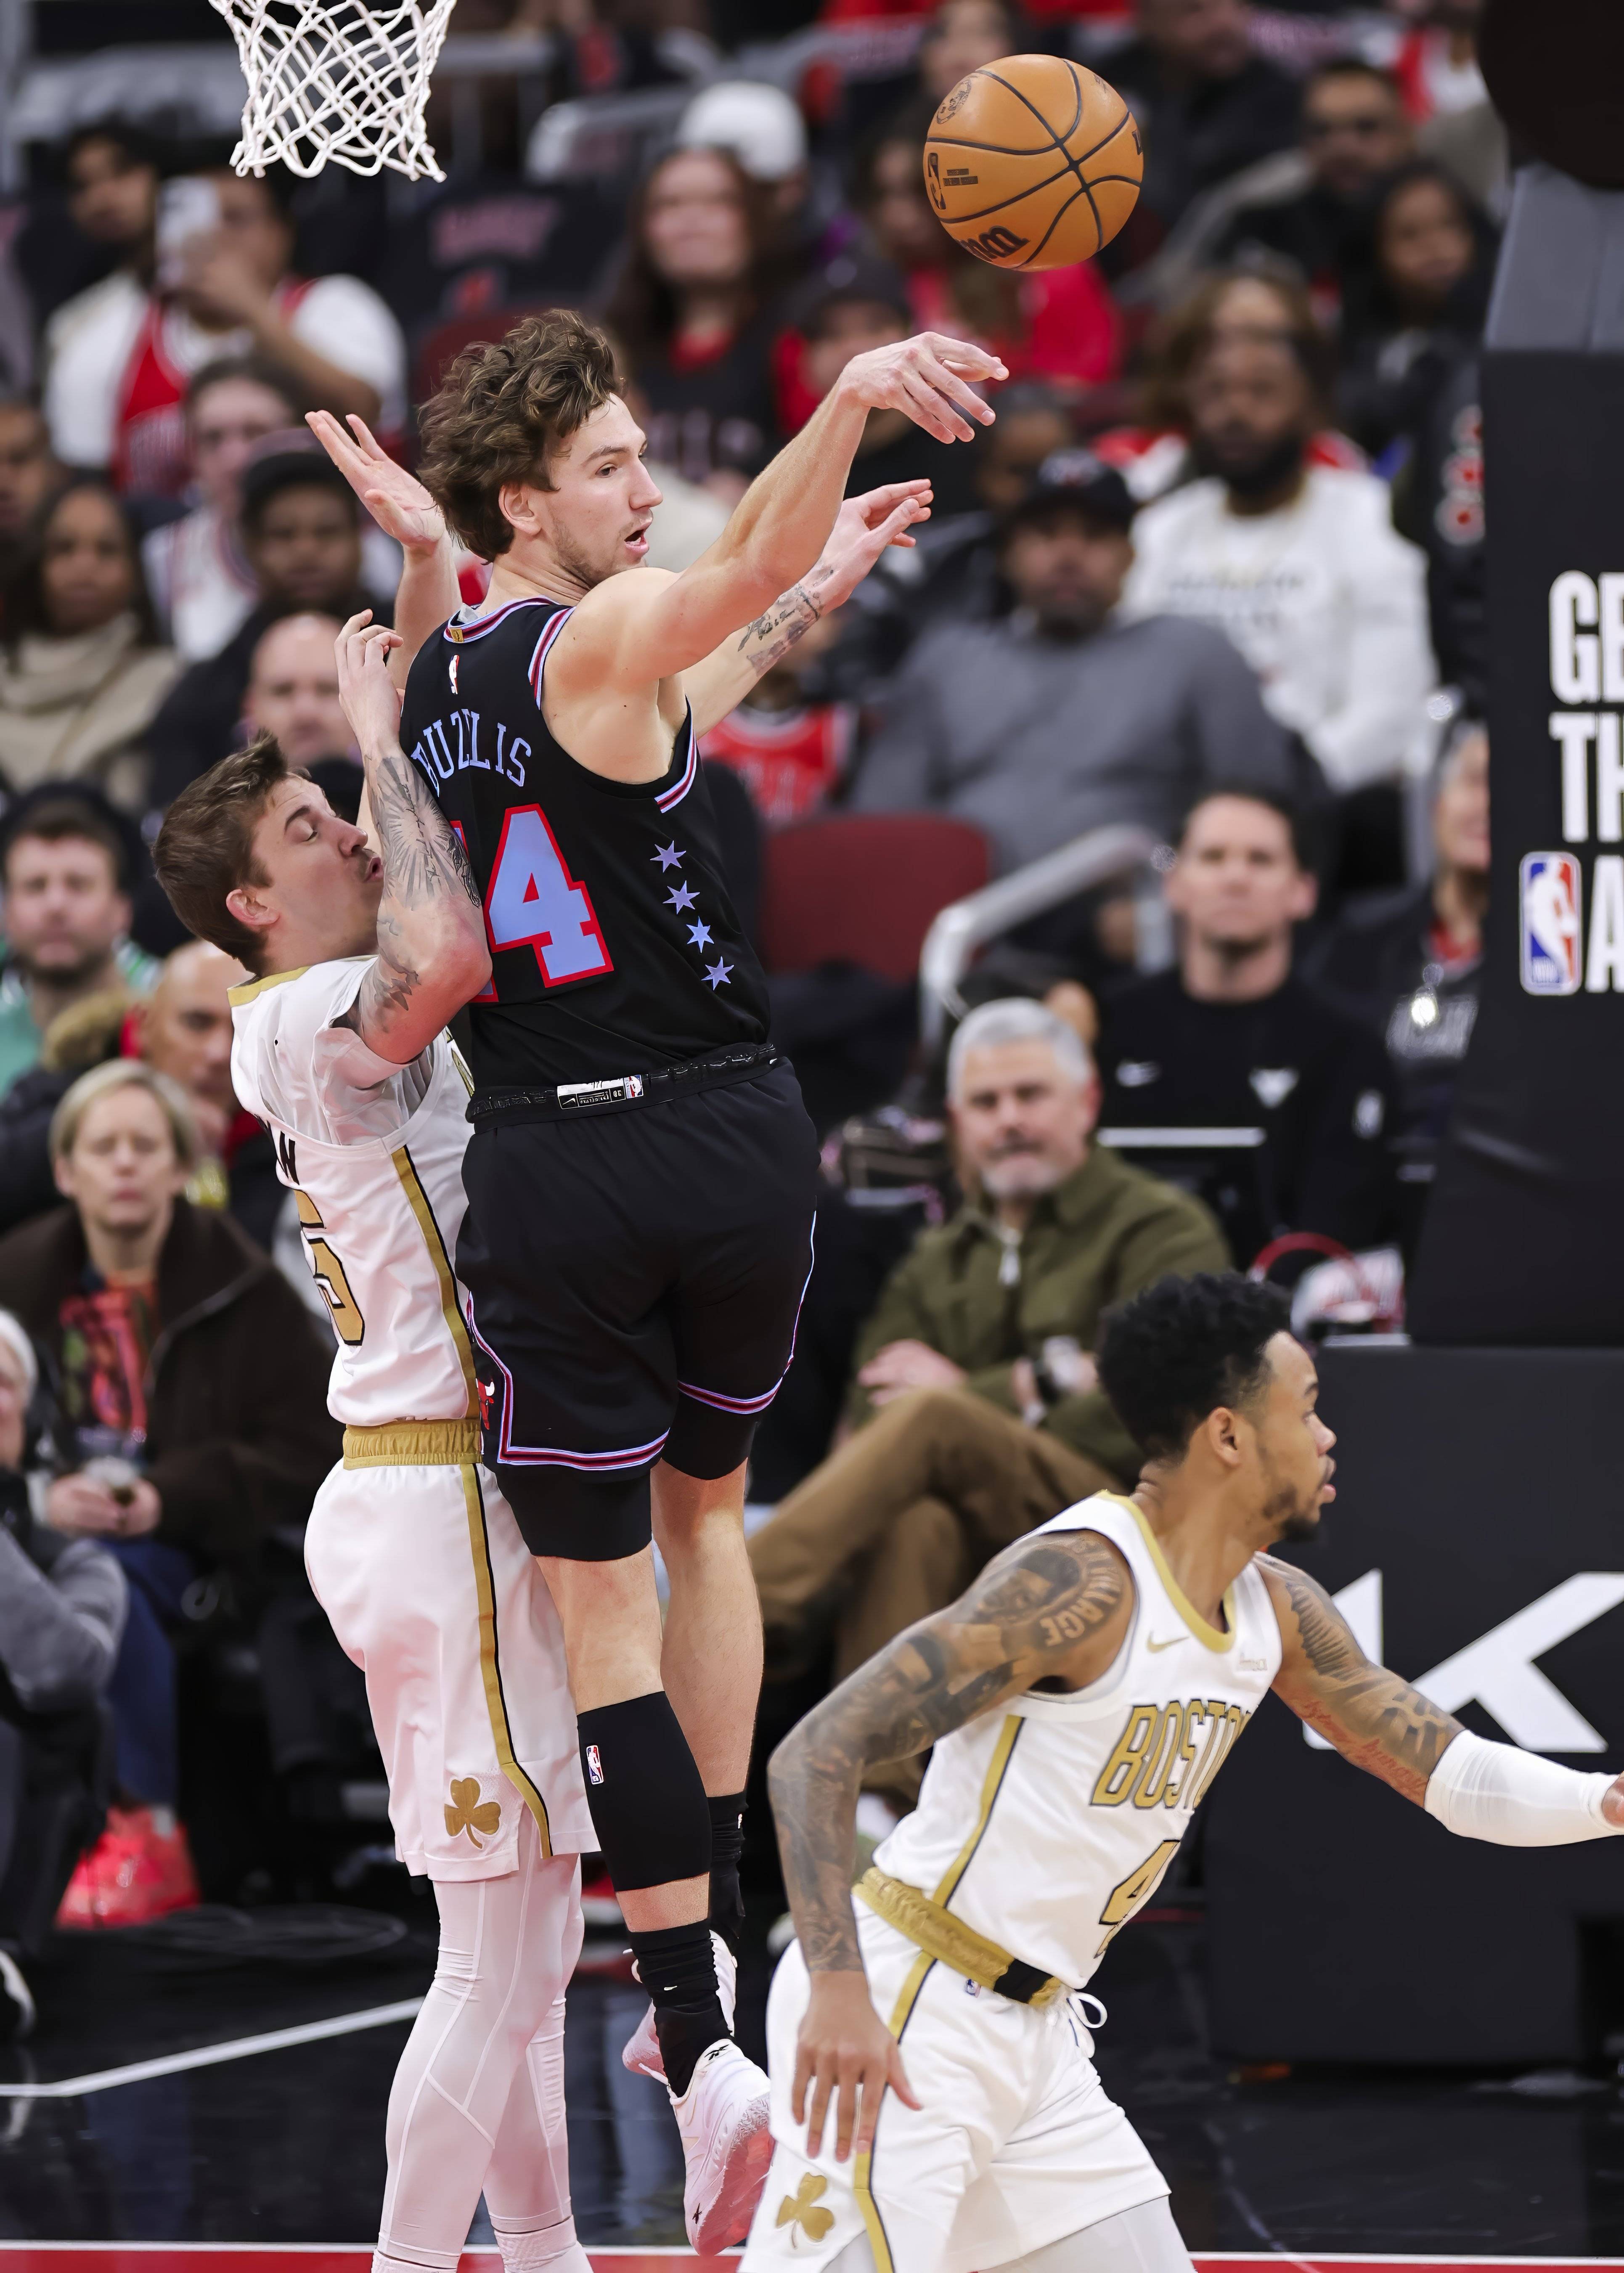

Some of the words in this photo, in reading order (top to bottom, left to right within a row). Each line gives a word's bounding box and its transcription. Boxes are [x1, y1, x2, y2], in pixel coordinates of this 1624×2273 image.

[411, 709, 531, 797] BUZLIS
[450, 803, 614, 1002] 4
[1584, 854, 1624, 993] A
[1089, 1699, 1252, 1809] BOSTO
